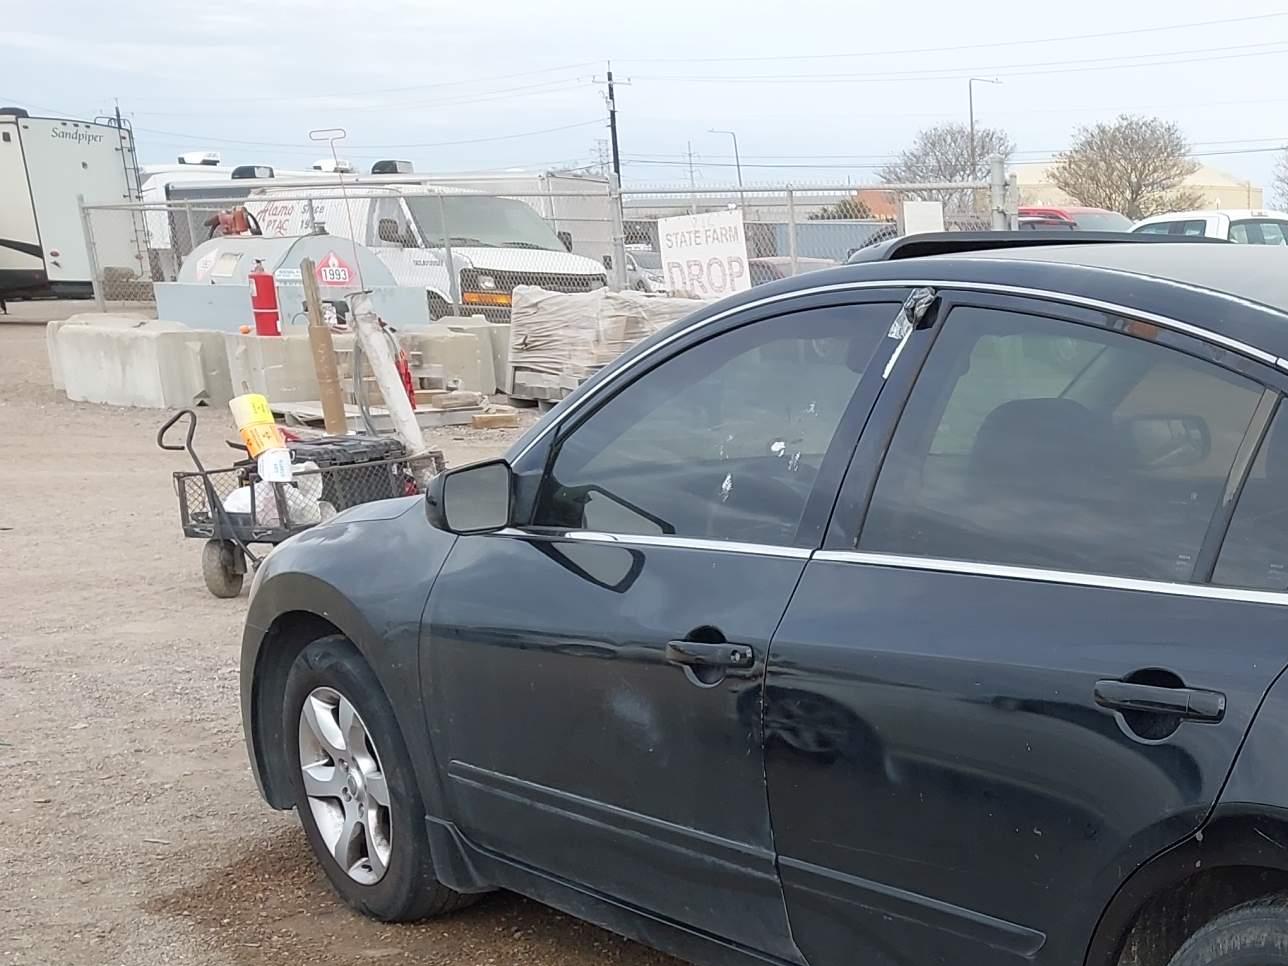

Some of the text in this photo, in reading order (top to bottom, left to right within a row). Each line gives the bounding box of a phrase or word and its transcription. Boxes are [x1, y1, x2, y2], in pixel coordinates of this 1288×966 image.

[51, 127, 104, 145] Sandpiper
[256, 200, 294, 222] Alamo
[665, 225, 739, 249] STATE FARM
[322, 268, 348, 281] 1993
[667, 256, 745, 295] DROP
